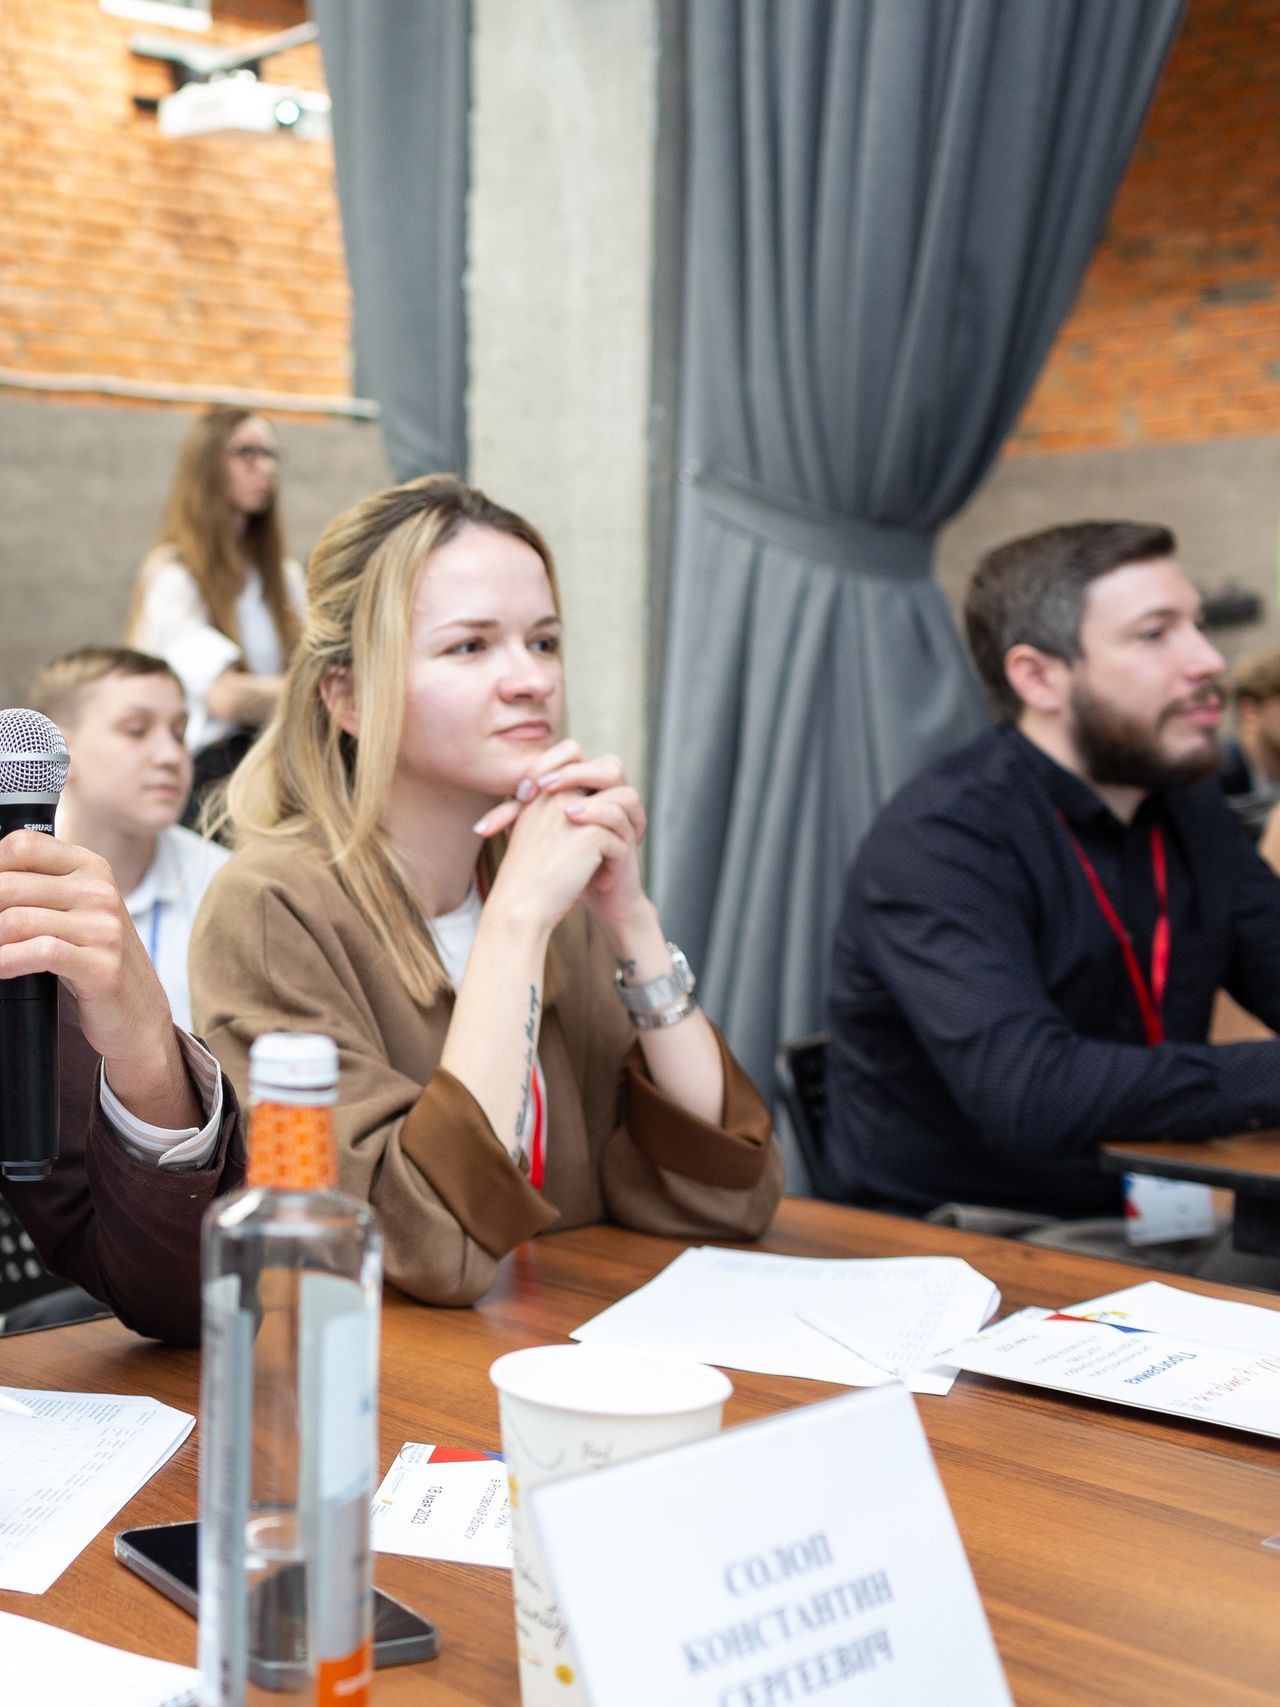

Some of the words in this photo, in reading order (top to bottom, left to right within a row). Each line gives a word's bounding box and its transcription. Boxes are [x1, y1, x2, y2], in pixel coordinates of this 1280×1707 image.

[24, 823, 53, 832] SHURE
[1124, 1351, 1198, 1385] Программа
[421, 1494, 436, 1508] мая
[427, 1485, 444, 1495] 18
[410, 1507, 432, 1525] 2023
[722, 1531, 834, 1598] СОЛОП
[681, 1569, 893, 1677] КОНСТАНТИН
[718, 1628, 894, 1707] СЕРГЕЕВИЧ
